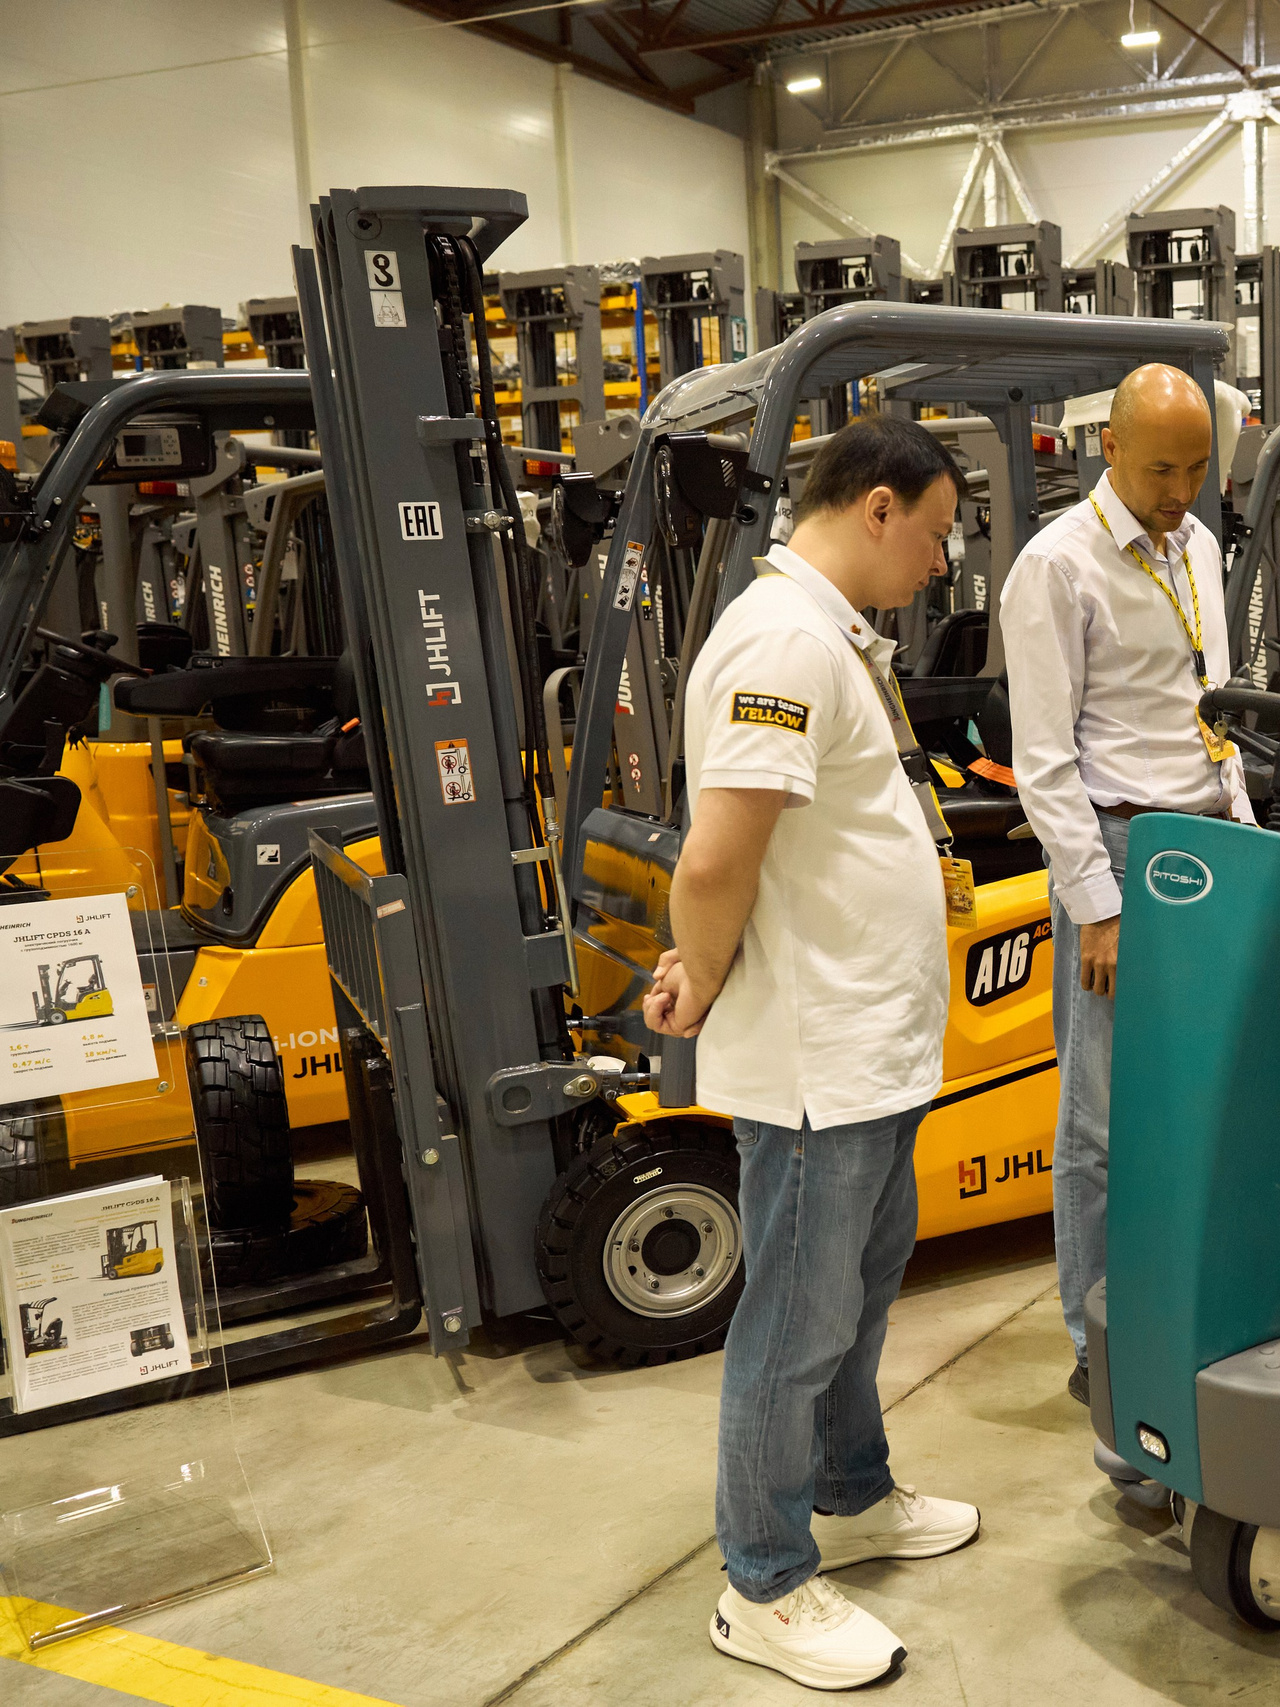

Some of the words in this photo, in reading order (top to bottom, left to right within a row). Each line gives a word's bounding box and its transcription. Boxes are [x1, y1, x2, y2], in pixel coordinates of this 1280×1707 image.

[403, 506, 440, 537] EAC
[418, 589, 452, 677] JHLIFT
[738, 695, 755, 704] we
[756, 696, 776, 706] are
[738, 706, 803, 729] YELLOW
[1152, 870, 1203, 886] PITOSHI
[86, 913, 112, 922] JHLIFT
[14, 934, 45, 943] JHLIFT
[46, 930, 72, 940] CPDS
[971, 932, 1030, 1000] A16
[150, 1360, 179, 1372] JHLIFT
[773, 1609, 790, 1626] FILA
